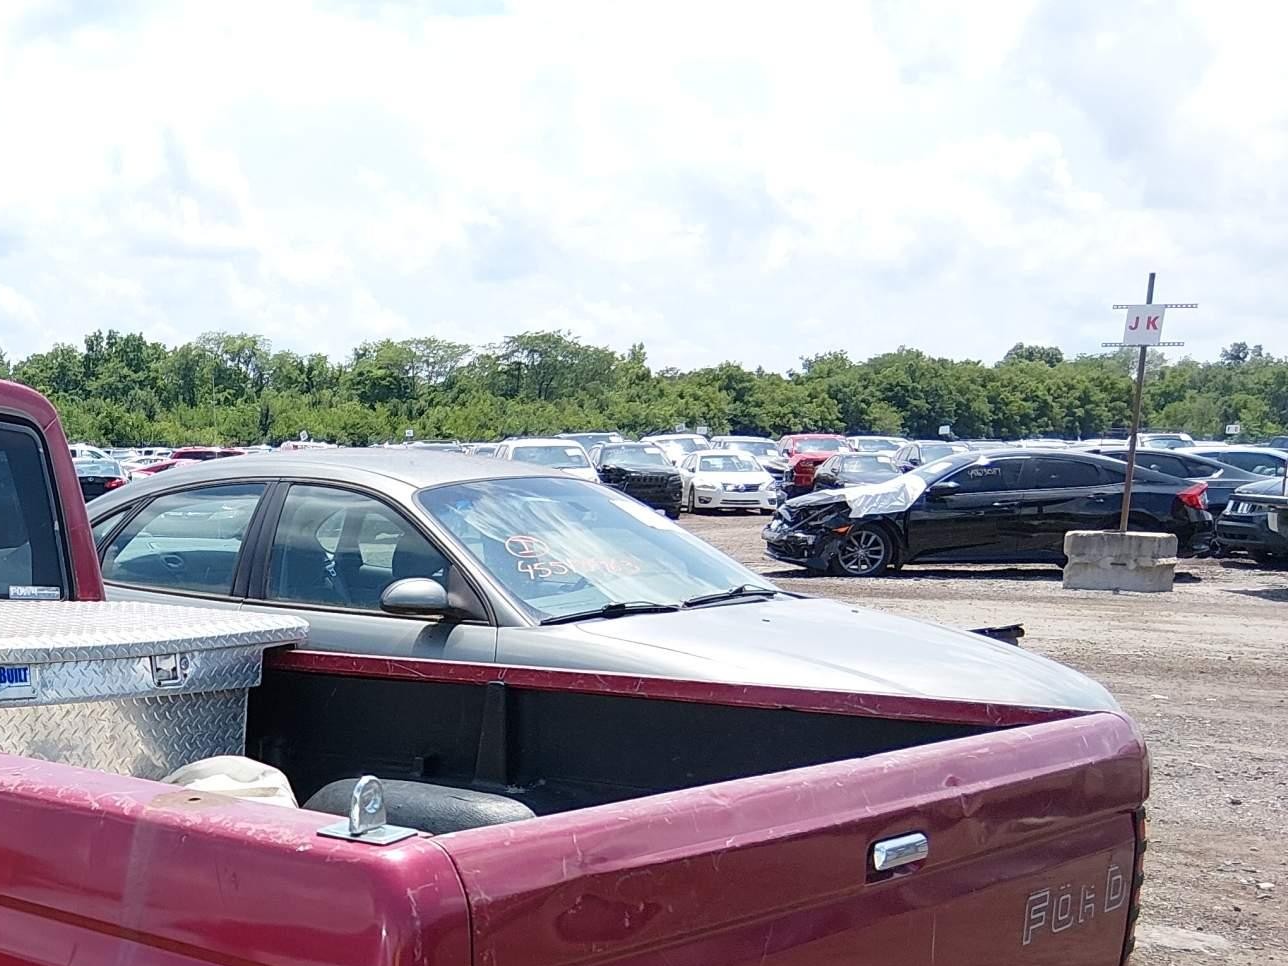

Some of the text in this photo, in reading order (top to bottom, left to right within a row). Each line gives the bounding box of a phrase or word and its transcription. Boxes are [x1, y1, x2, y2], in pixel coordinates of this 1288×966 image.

[1128, 315, 1160, 331] J K
[1022, 865, 1128, 946] FORD
